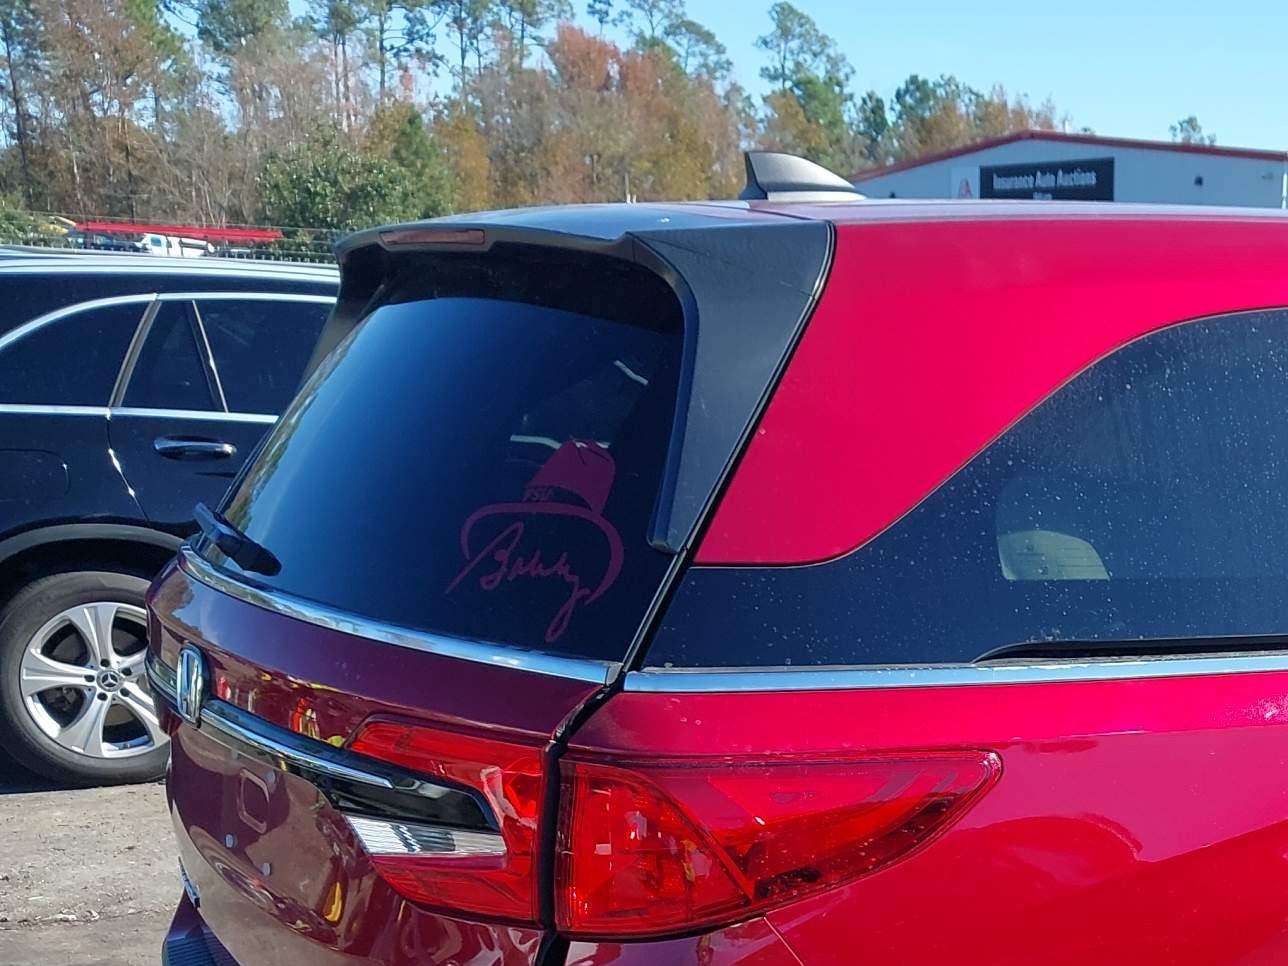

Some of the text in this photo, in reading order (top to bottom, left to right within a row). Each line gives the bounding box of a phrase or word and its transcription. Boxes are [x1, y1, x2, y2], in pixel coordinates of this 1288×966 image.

[993, 172, 1034, 190] Insurance
[1035, 170, 1056, 188] Auto
[1057, 168, 1097, 187] Auctions
